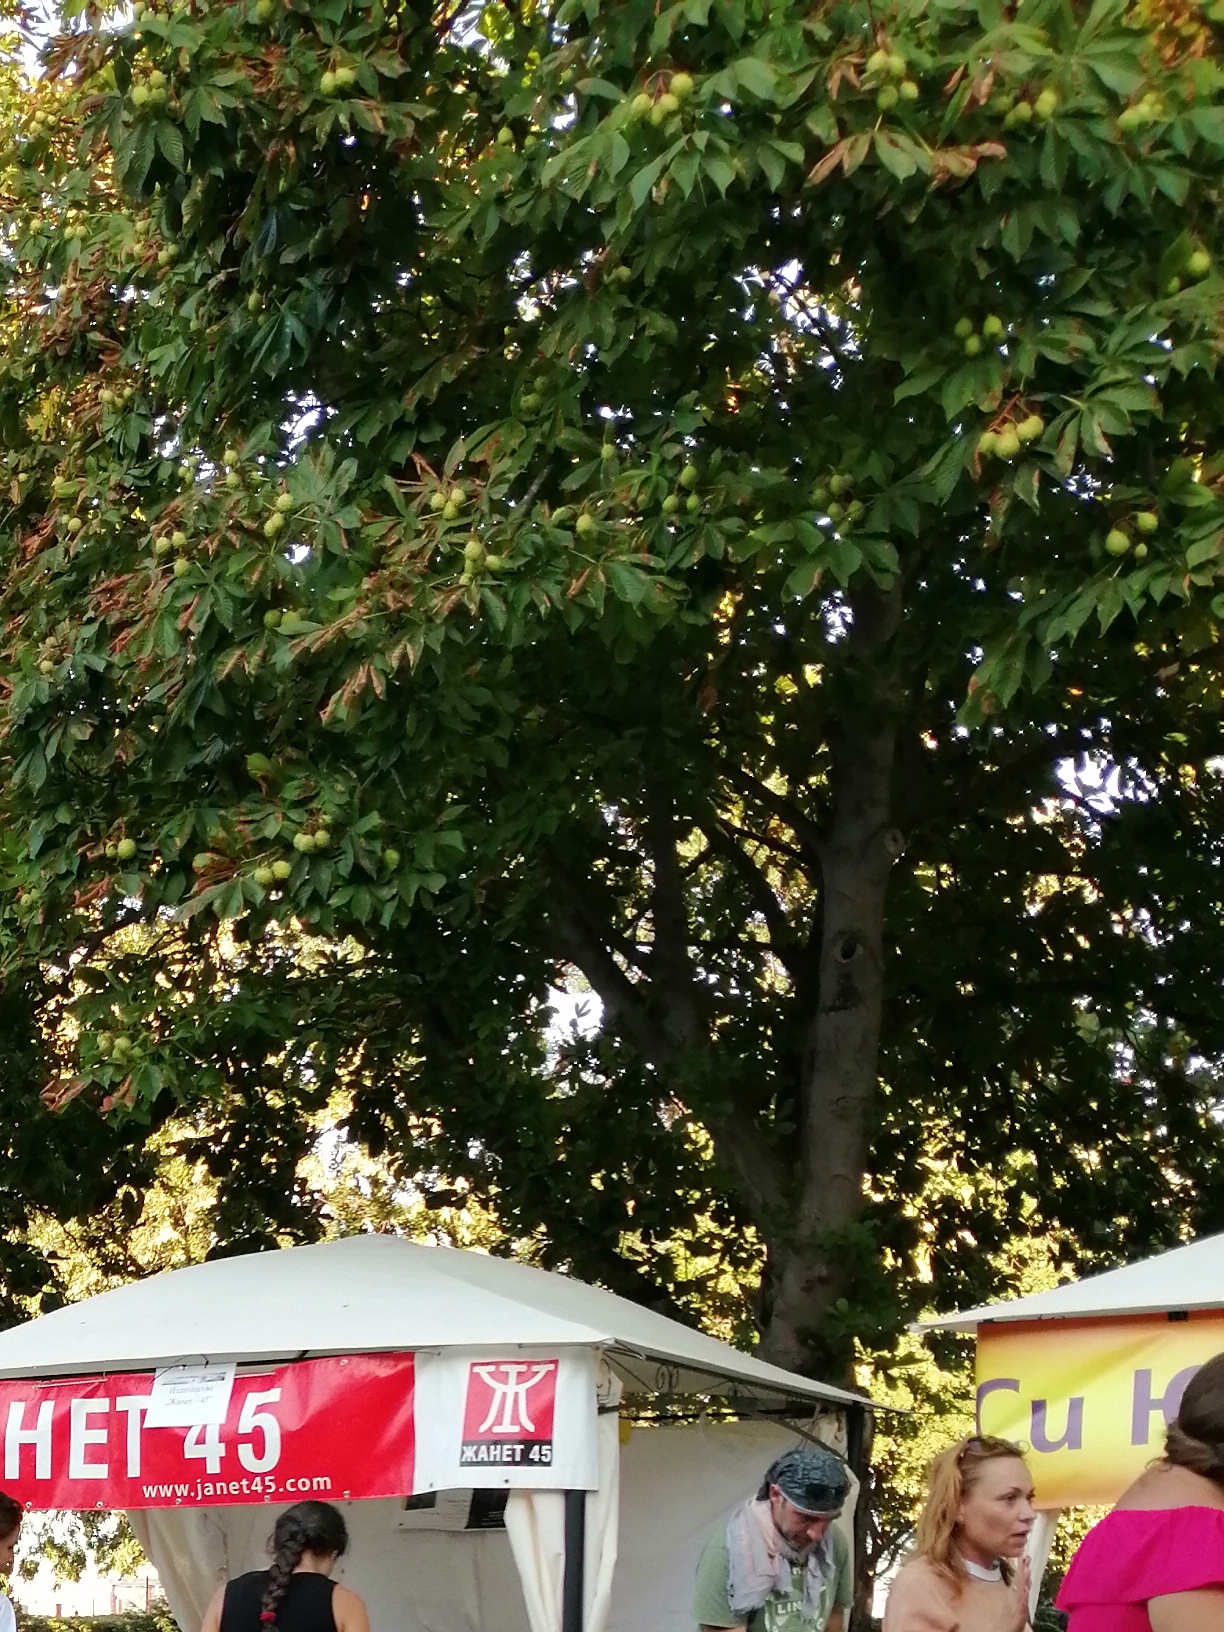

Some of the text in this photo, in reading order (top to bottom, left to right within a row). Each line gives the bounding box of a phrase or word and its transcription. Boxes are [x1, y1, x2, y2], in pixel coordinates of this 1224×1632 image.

[184, 1388, 282, 1474] 45
[461, 1444, 552, 1463] ЖАНЕТ 45
[142, 1475, 332, 1501] www.janet45.com
[777, 1600, 802, 1615] LIN
